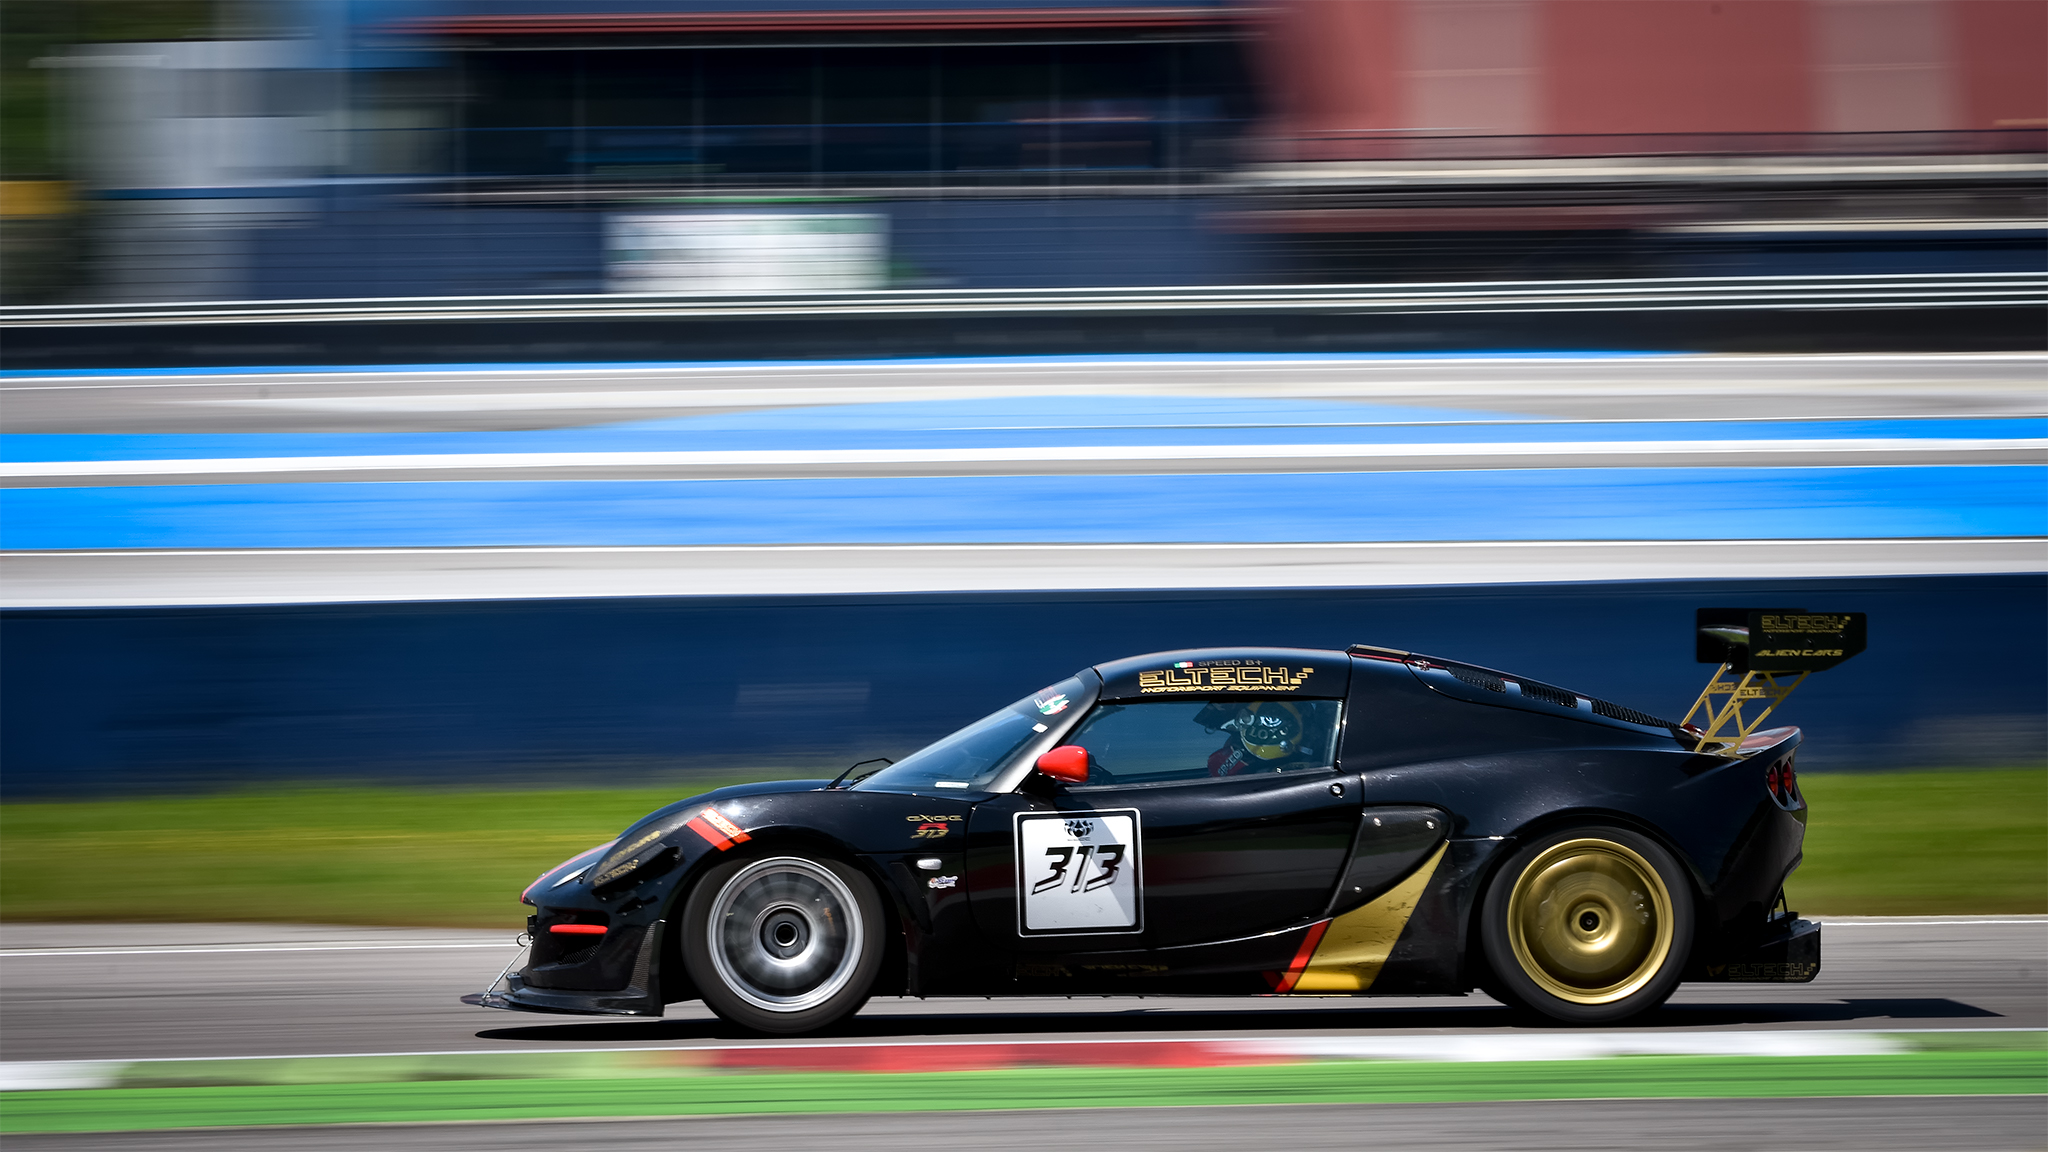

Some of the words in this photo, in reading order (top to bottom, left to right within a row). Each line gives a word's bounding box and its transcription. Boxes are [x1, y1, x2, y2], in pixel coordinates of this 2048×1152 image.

[1761, 615, 1838, 629] ELTECH
[1755, 649, 1801, 657] ALIEN
[1802, 649, 1843, 657] CARS
[1139, 667, 1289, 687] ELTECH
[1141, 685, 1227, 693] MOTORSPORT
[1227, 684, 1300, 692] EQUIPMENT
[910, 829, 949, 839] 313
[1031, 844, 1126, 896] 313
[1728, 962, 1804, 977] ELTECH
